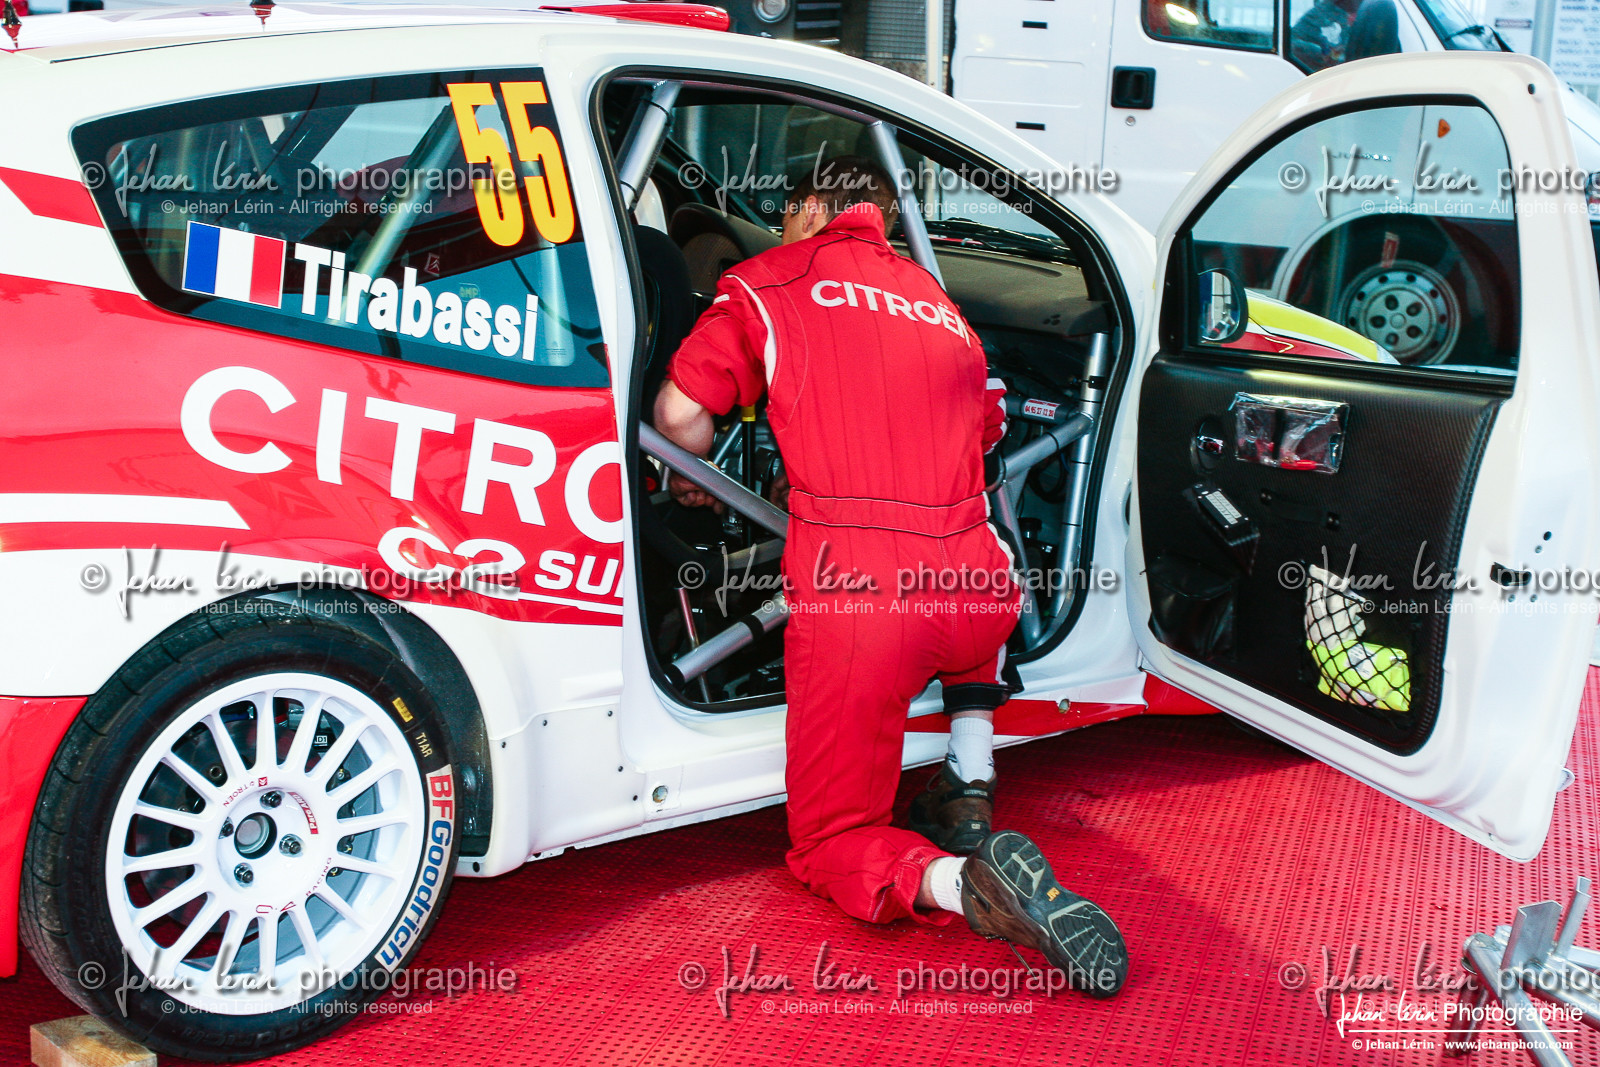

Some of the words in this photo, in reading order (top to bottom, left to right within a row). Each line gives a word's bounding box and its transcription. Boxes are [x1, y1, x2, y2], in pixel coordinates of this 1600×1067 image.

[446, 81, 575, 247] 55
[294, 242, 538, 362] Tirabassi
[377, 526, 526, 602] C2
[534, 549, 624, 598] SU
[380, 774, 453, 966] BFGoodrich
